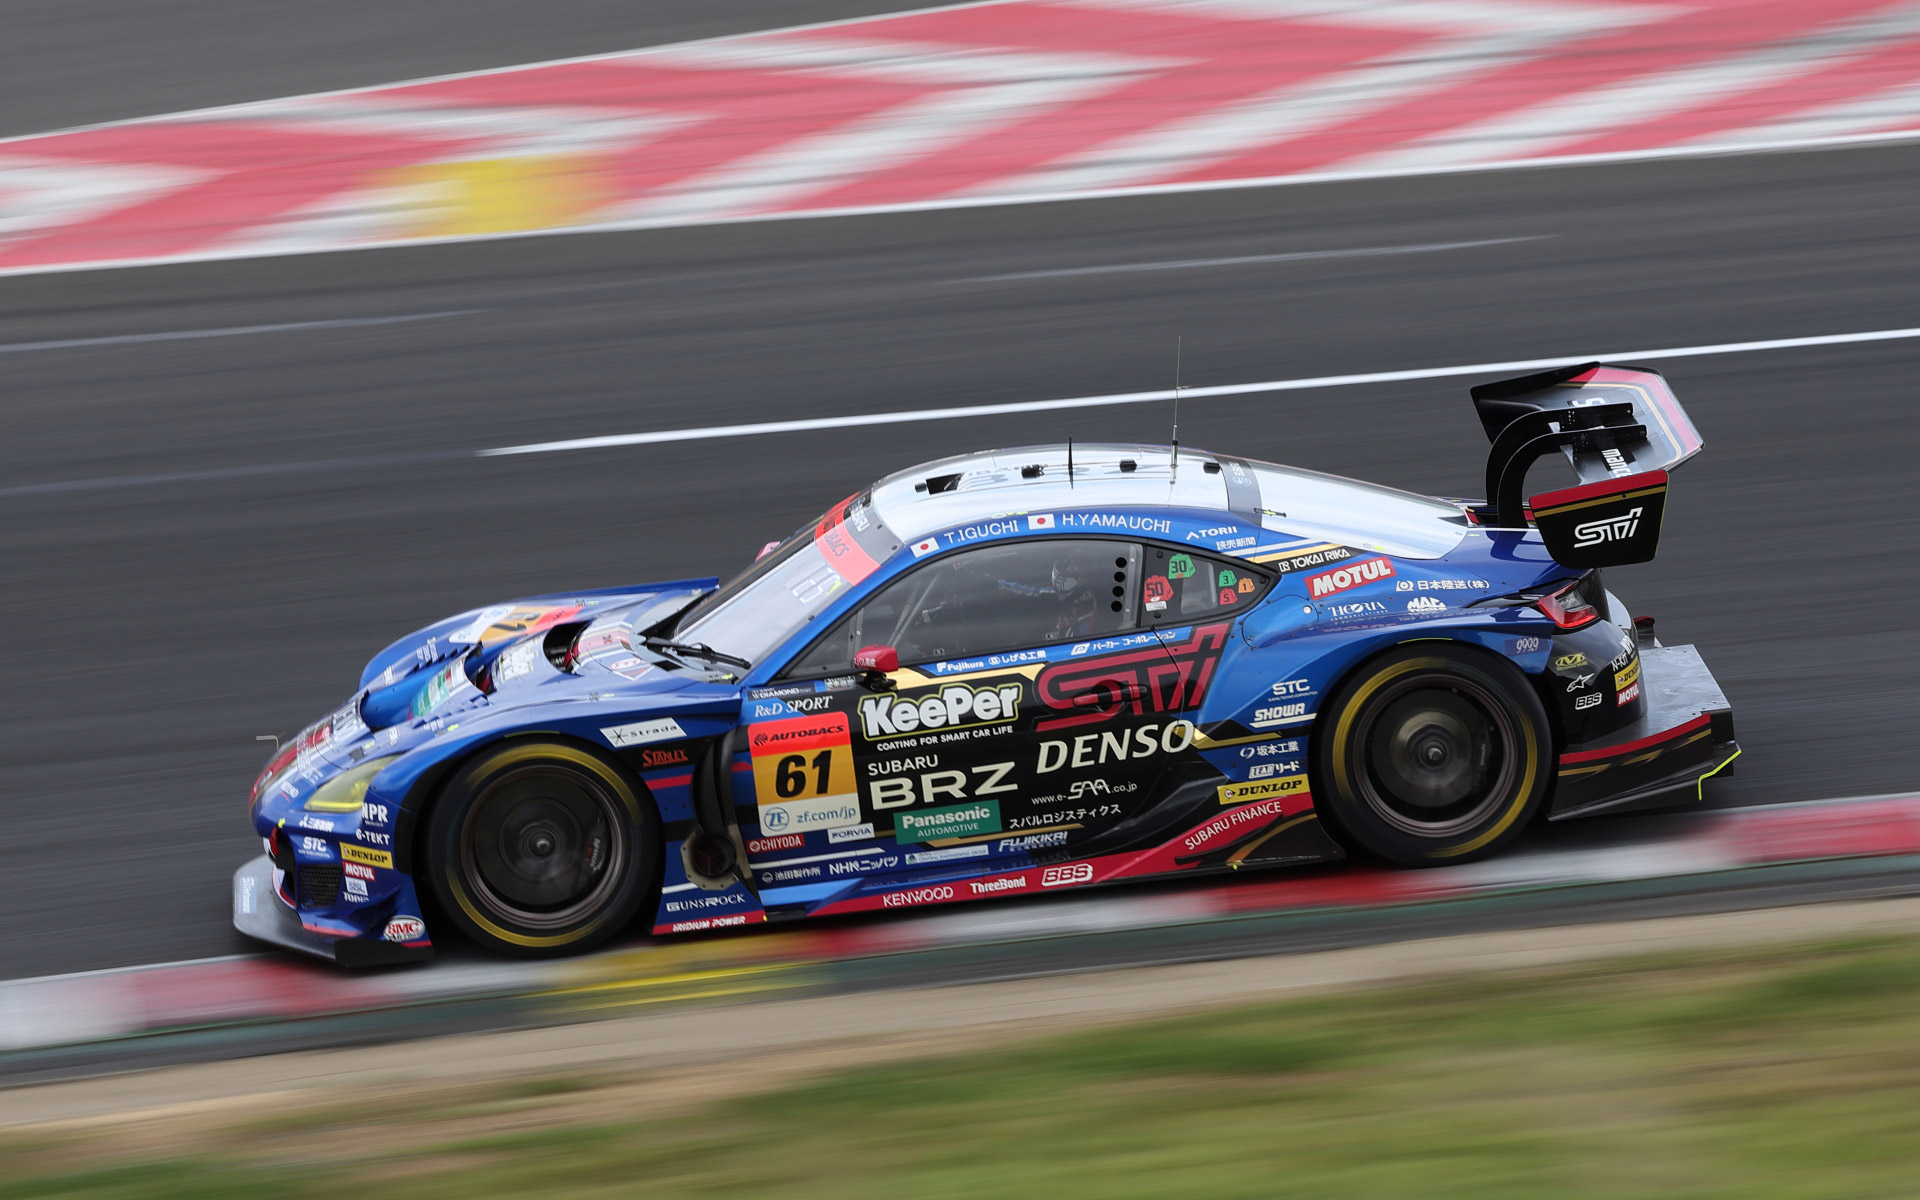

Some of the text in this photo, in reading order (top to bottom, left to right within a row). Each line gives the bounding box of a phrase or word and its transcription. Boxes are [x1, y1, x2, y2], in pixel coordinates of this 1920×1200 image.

[944, 520, 1019, 544] T.IGUCHI
[1062, 513, 1171, 534] H.YAMAUCHI
[1170, 560, 1187, 574] 30
[1291, 548, 1351, 569] TOKAI RIKA
[1223, 575, 1229, 585] 3
[1314, 560, 1391, 597] MOTUL
[1146, 581, 1164, 597] 50
[1224, 593, 1230, 603] 5
[760, 687, 800, 699] DIAMOND
[1272, 679, 1310, 695] STC
[1619, 684, 1640, 705] MOTUL
[754, 696, 834, 718] R&D SPORT
[1575, 692, 1602, 710] BBS
[1254, 702, 1306, 721] SHOWA
[770, 725, 844, 742] AUTOBACS
[877, 725, 1014, 752] COATING FOR SMART CAR LIFE
[1036, 719, 1195, 774] DENSO
[775, 750, 832, 798] 61
[868, 754, 939, 776] SUBARU
[869, 761, 1018, 810] BRZ
[1237, 780, 1303, 796] DUNLOP
[361, 802, 389, 823] NPR
[796, 807, 856, 824] zf.com/jp
[902, 806, 991, 830] Panasonic
[1009, 803, 1122, 830] スバルロジスティクス
[831, 827, 871, 840] FORVIA
[917, 822, 979, 838] AUTOMOTIVE
[1184, 801, 1282, 850] SUBARU FINANCE
[303, 836, 327, 853] STC
[760, 835, 802, 851] CHIYODA
[351, 849, 387, 862] DUNLOP
[345, 862, 375, 880] MOTUL
[1042, 864, 1093, 887] BBS
[969, 876, 1026, 895] ThreeBond
[883, 886, 954, 908] KENWOOD
[387, 922, 420, 935] BMC
